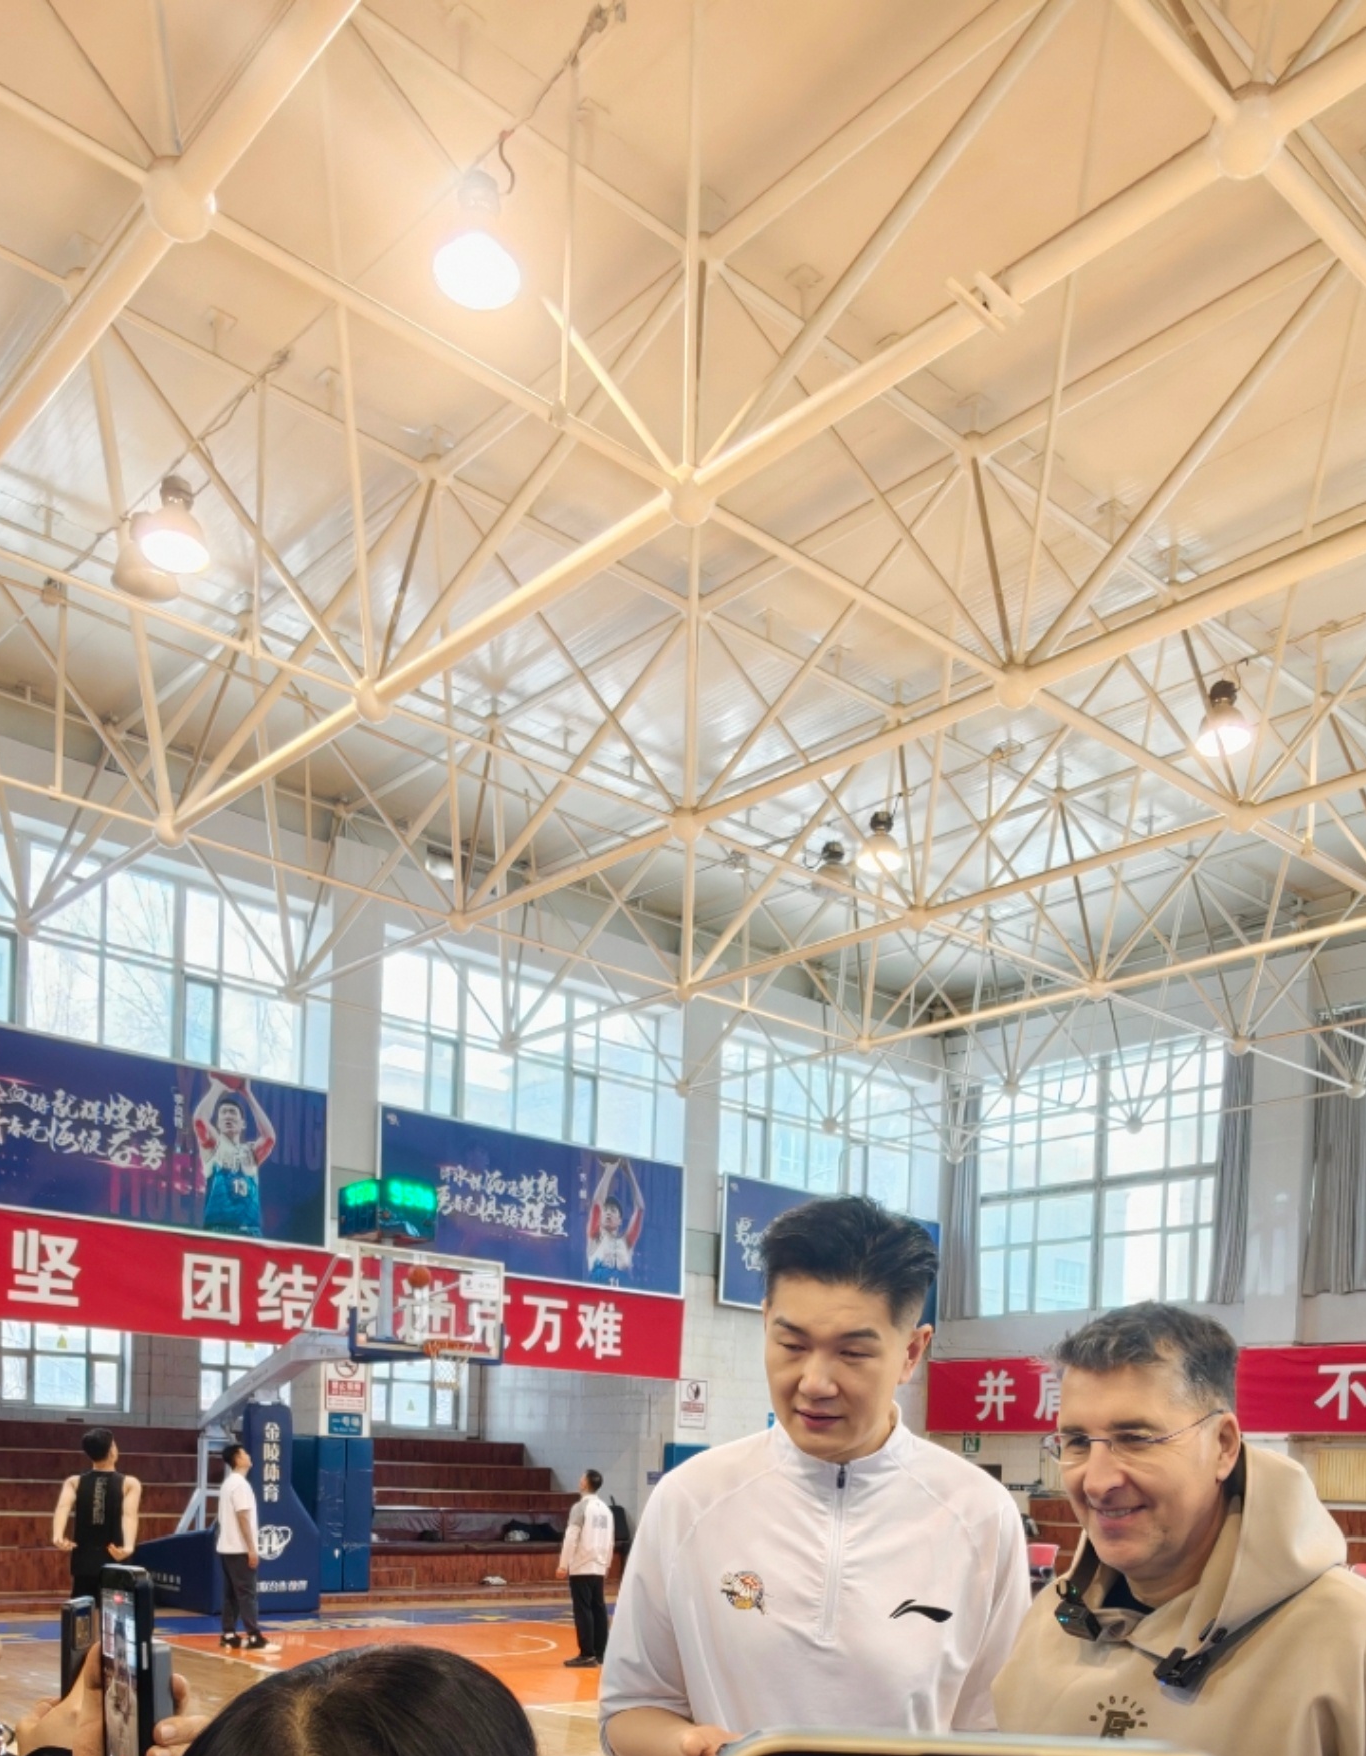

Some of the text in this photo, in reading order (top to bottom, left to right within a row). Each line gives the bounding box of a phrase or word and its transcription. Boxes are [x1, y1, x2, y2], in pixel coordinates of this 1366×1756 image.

[181, 1252, 624, 1360] 团结奋进克万难
[263, 1422, 280, 1503] 金陵体育
